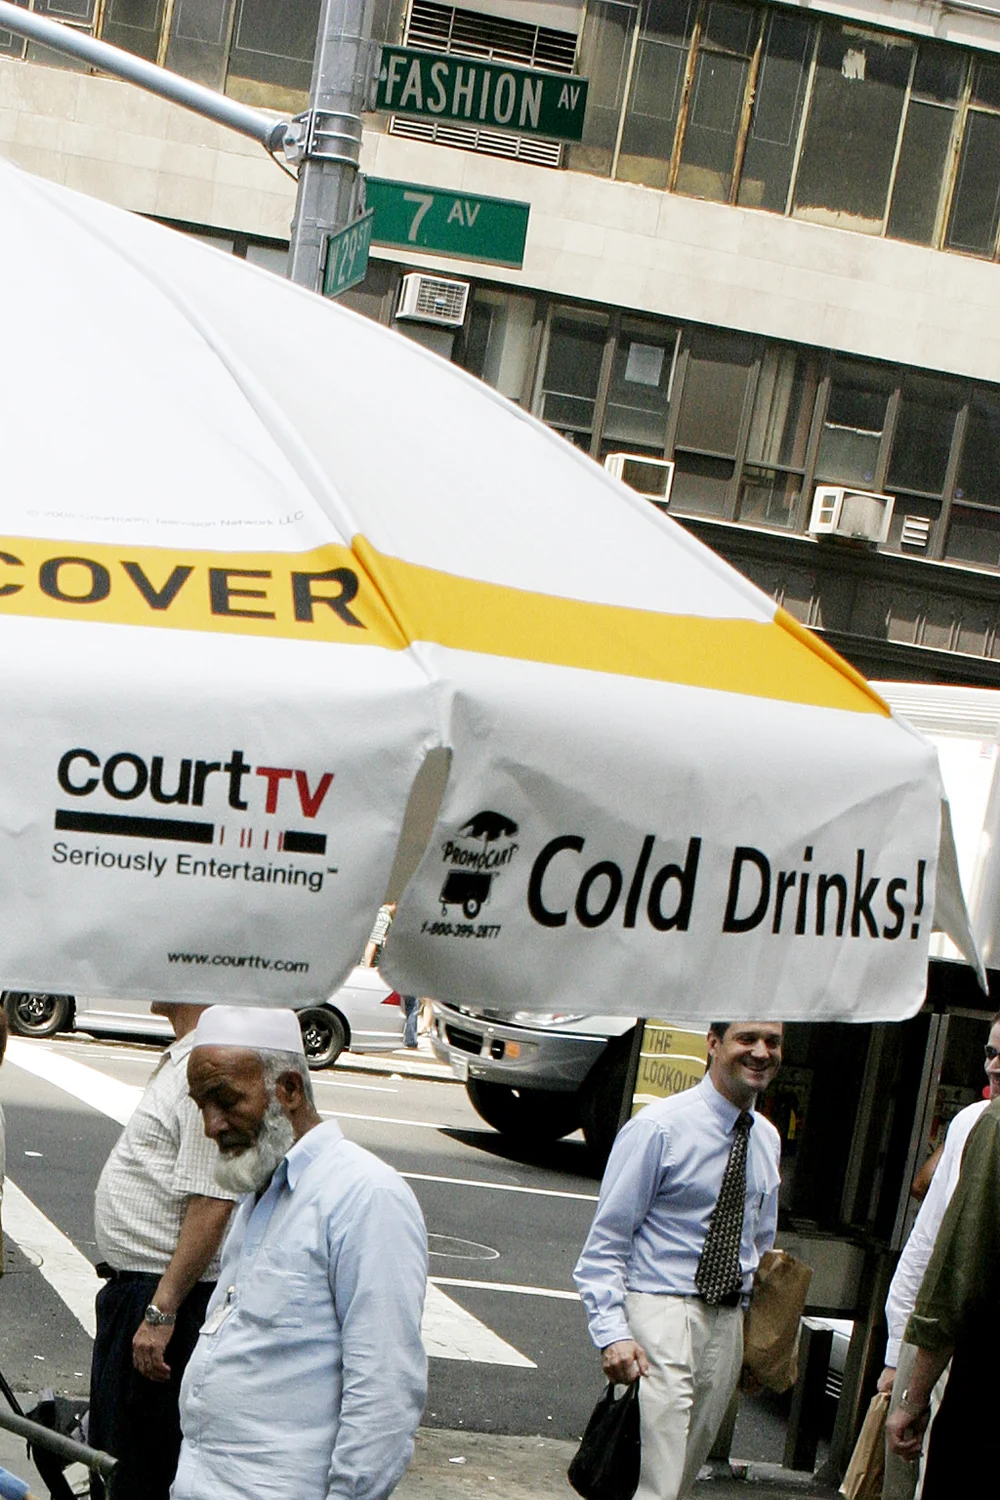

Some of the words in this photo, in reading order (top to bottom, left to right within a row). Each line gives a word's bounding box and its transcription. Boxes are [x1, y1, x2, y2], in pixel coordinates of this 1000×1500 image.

[385, 55, 543, 128] FASHION
[557, 84, 580, 110] AV
[402, 193, 434, 242] 7
[447, 203, 480, 228] AV
[220, 518, 274, 527] Network
[279, 510, 305, 526] LLC
[52, 842, 168, 878] Seriously
[527, 834, 702, 933] Cold
[722, 846, 927, 940] Drinks!
[167, 952, 310, 973] www.courttv.com
[649, 1029, 673, 1054] THE
